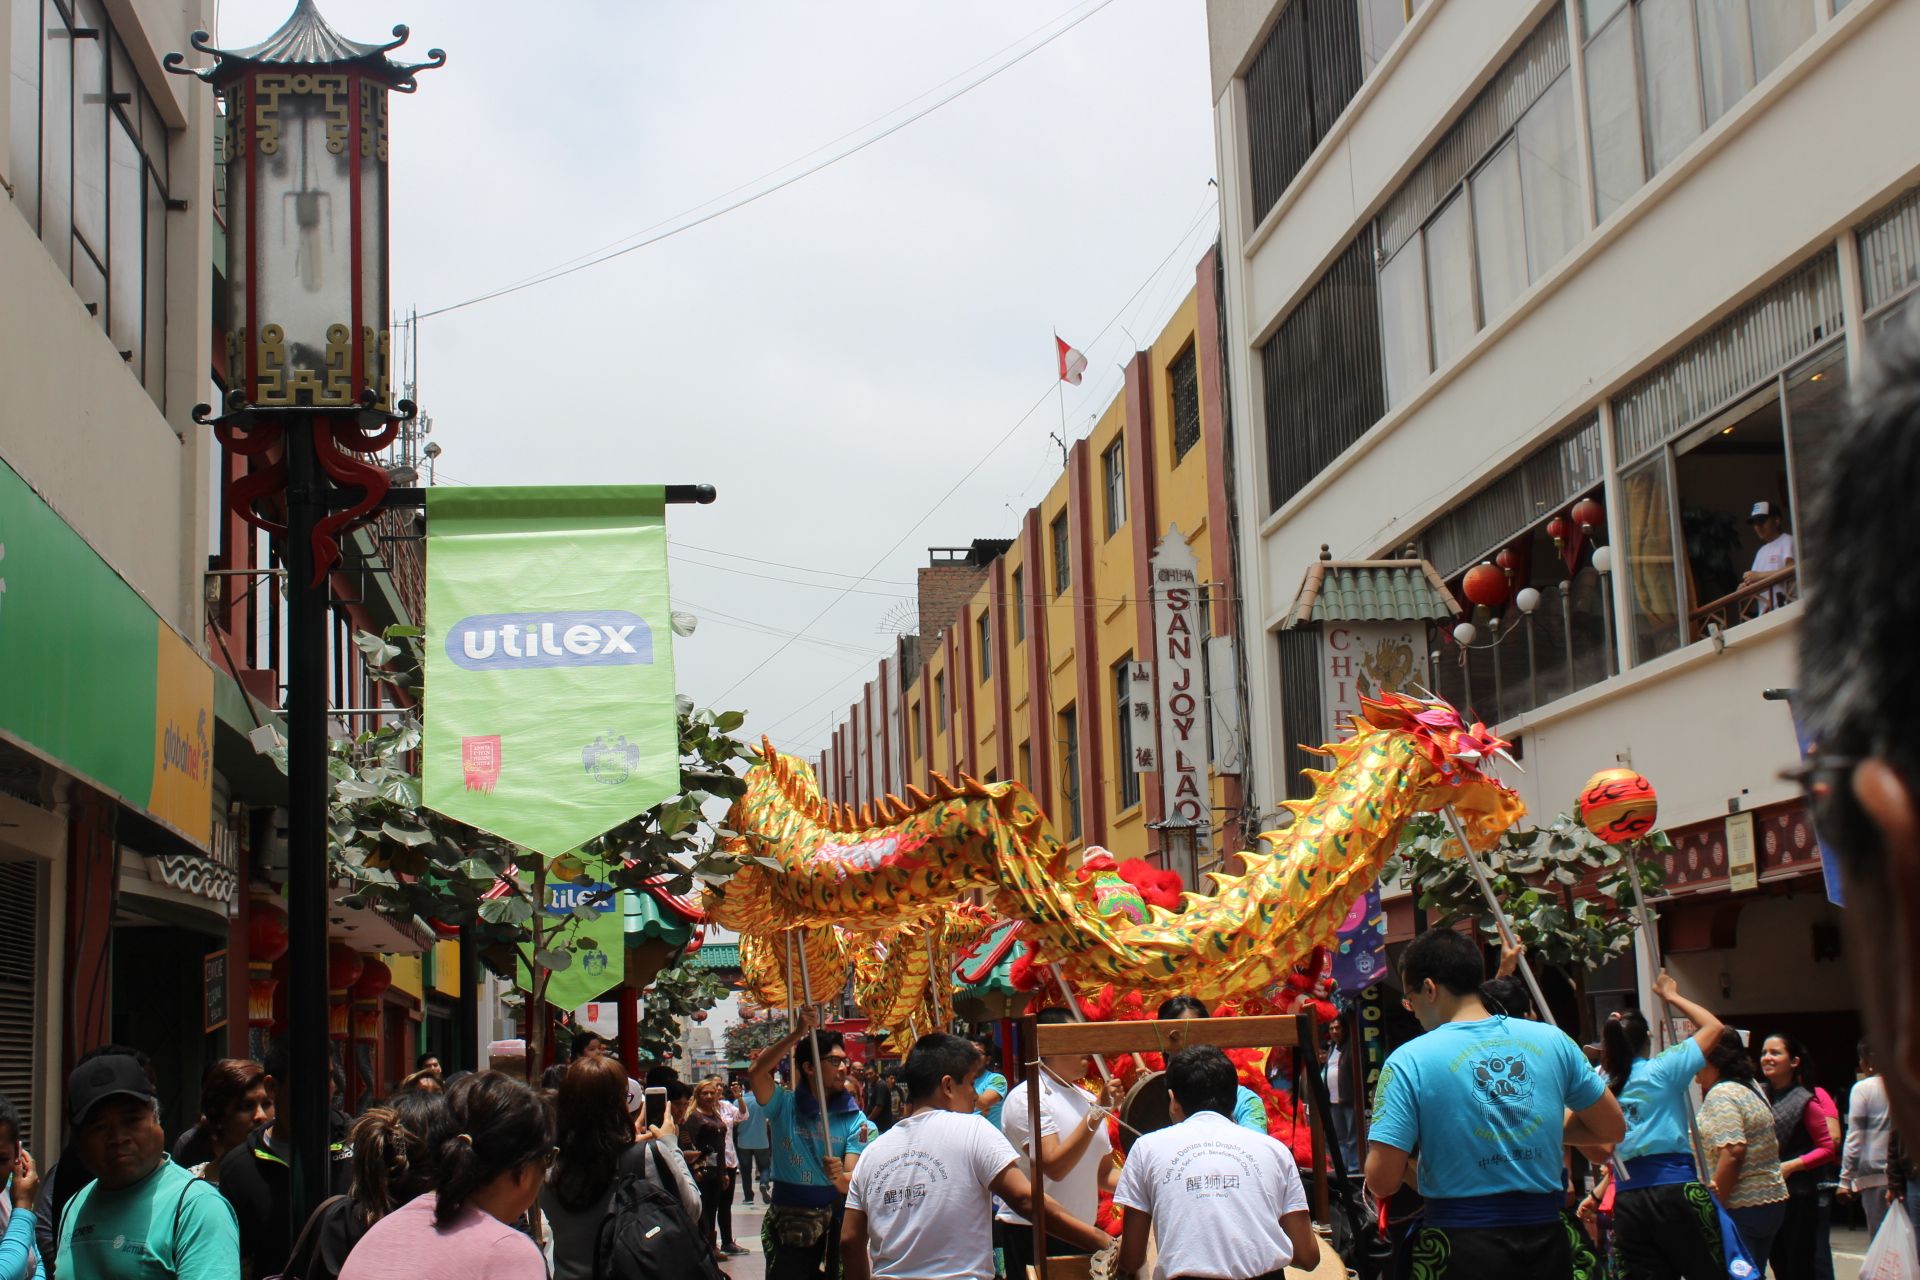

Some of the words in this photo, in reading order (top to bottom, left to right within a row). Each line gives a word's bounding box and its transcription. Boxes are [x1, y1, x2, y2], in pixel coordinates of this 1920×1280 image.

[463, 622, 637, 659] utilex
[1166, 588, 1192, 660] SAN
[1168, 668, 1196, 741] JOY
[1174, 749, 1202, 821] LAO
[1171, 1156, 1180, 1165] de
[1177, 1143, 1202, 1157] Danzas
[1216, 1141, 1241, 1151] Dragón
